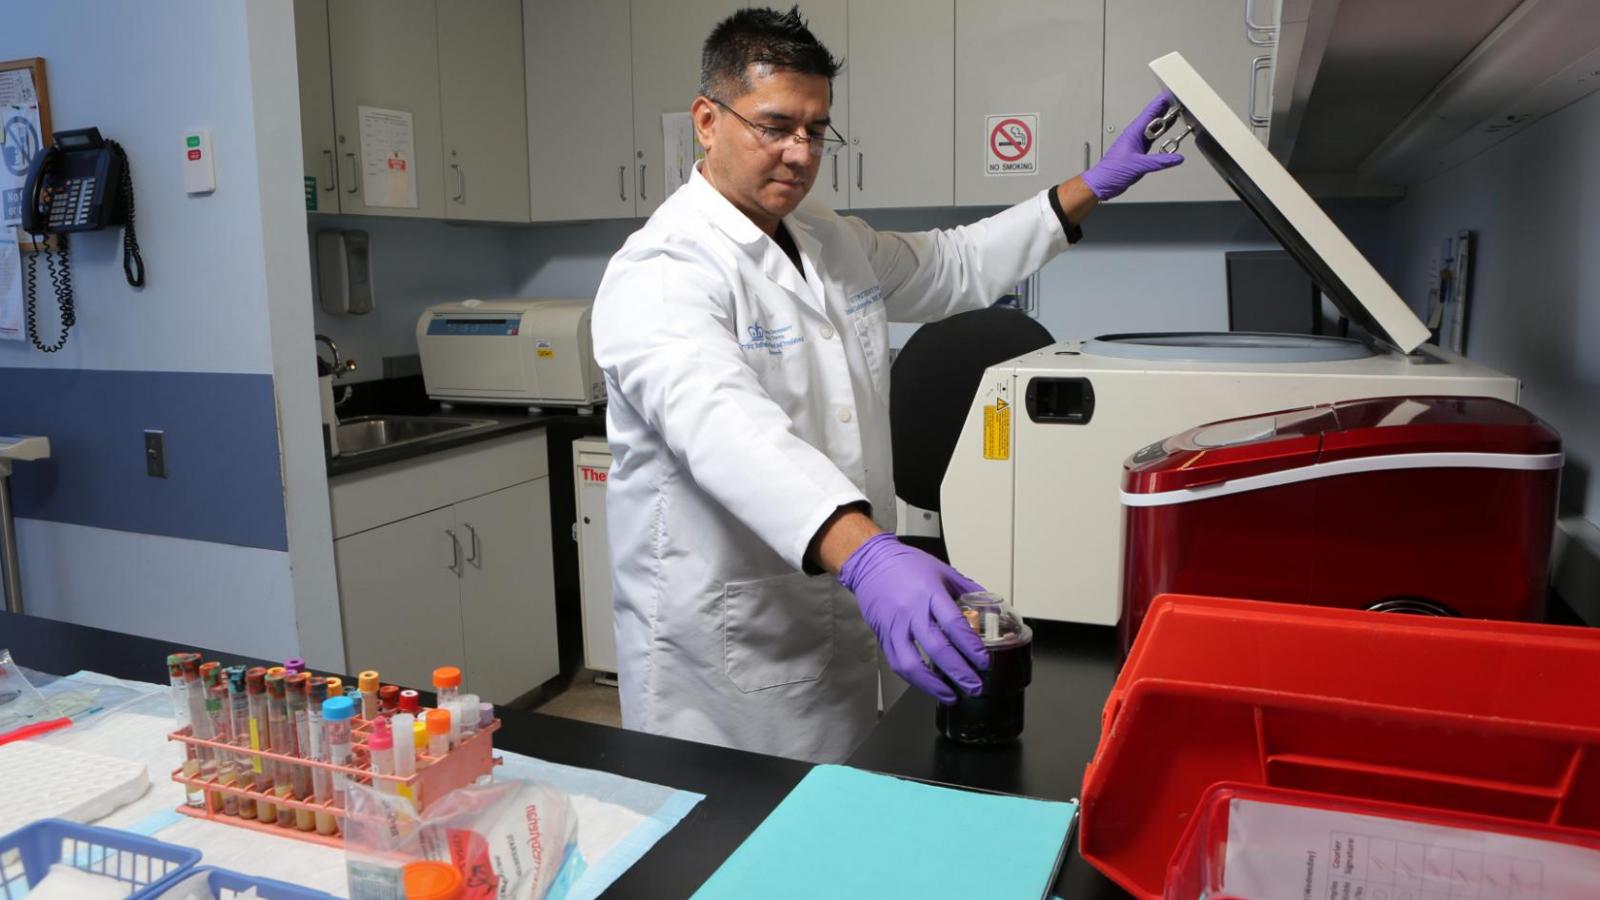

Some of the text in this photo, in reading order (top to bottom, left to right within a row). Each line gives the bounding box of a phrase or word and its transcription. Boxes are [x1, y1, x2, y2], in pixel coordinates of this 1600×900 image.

[989, 162, 1033, 171] NO SMOKING
[1332, 840, 1342, 869] Courier
[1344, 838, 1354, 875] Signature
[1303, 850, 1316, 897] (Wednesday)
